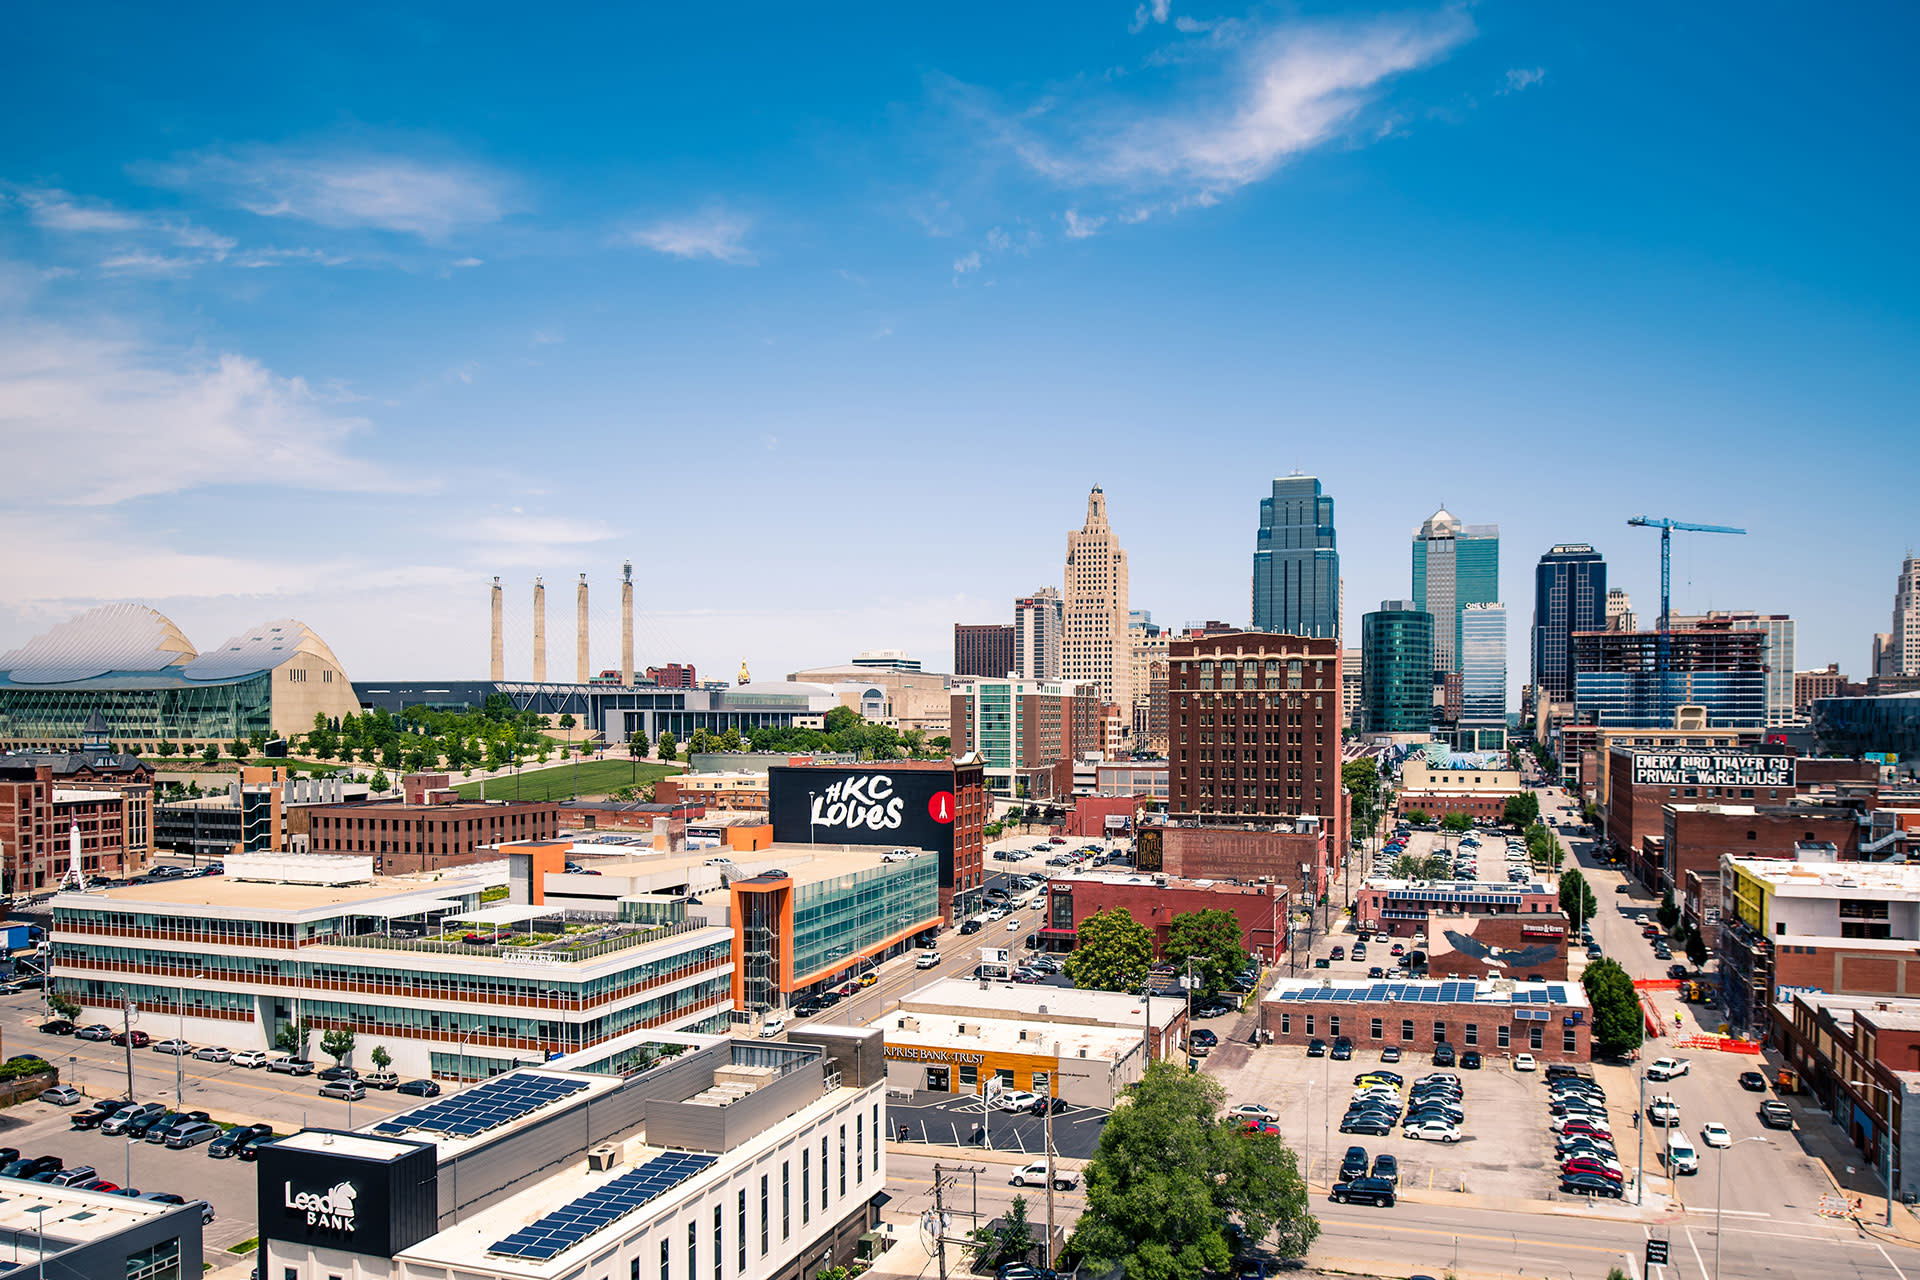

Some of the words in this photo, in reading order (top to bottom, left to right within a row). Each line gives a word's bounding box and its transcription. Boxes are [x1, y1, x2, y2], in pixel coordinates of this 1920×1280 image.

[1636, 756, 1677, 769] EMERY
[1680, 756, 1711, 770] BIRD
[1713, 757, 1765, 770] THAYER
[1769, 758, 1793, 771] CO.
[1638, 769, 1690, 784] PRIVATE
[1697, 770, 1788, 785] WAREHOUSE
[825, 775, 893, 806] #KC
[883, 1046, 918, 1058] RPRISE
[920, 1048, 948, 1061] BANK
[954, 1052, 984, 1064] TRUST
[285, 1181, 333, 1214] Lead
[307, 1211, 355, 1232] BANK
